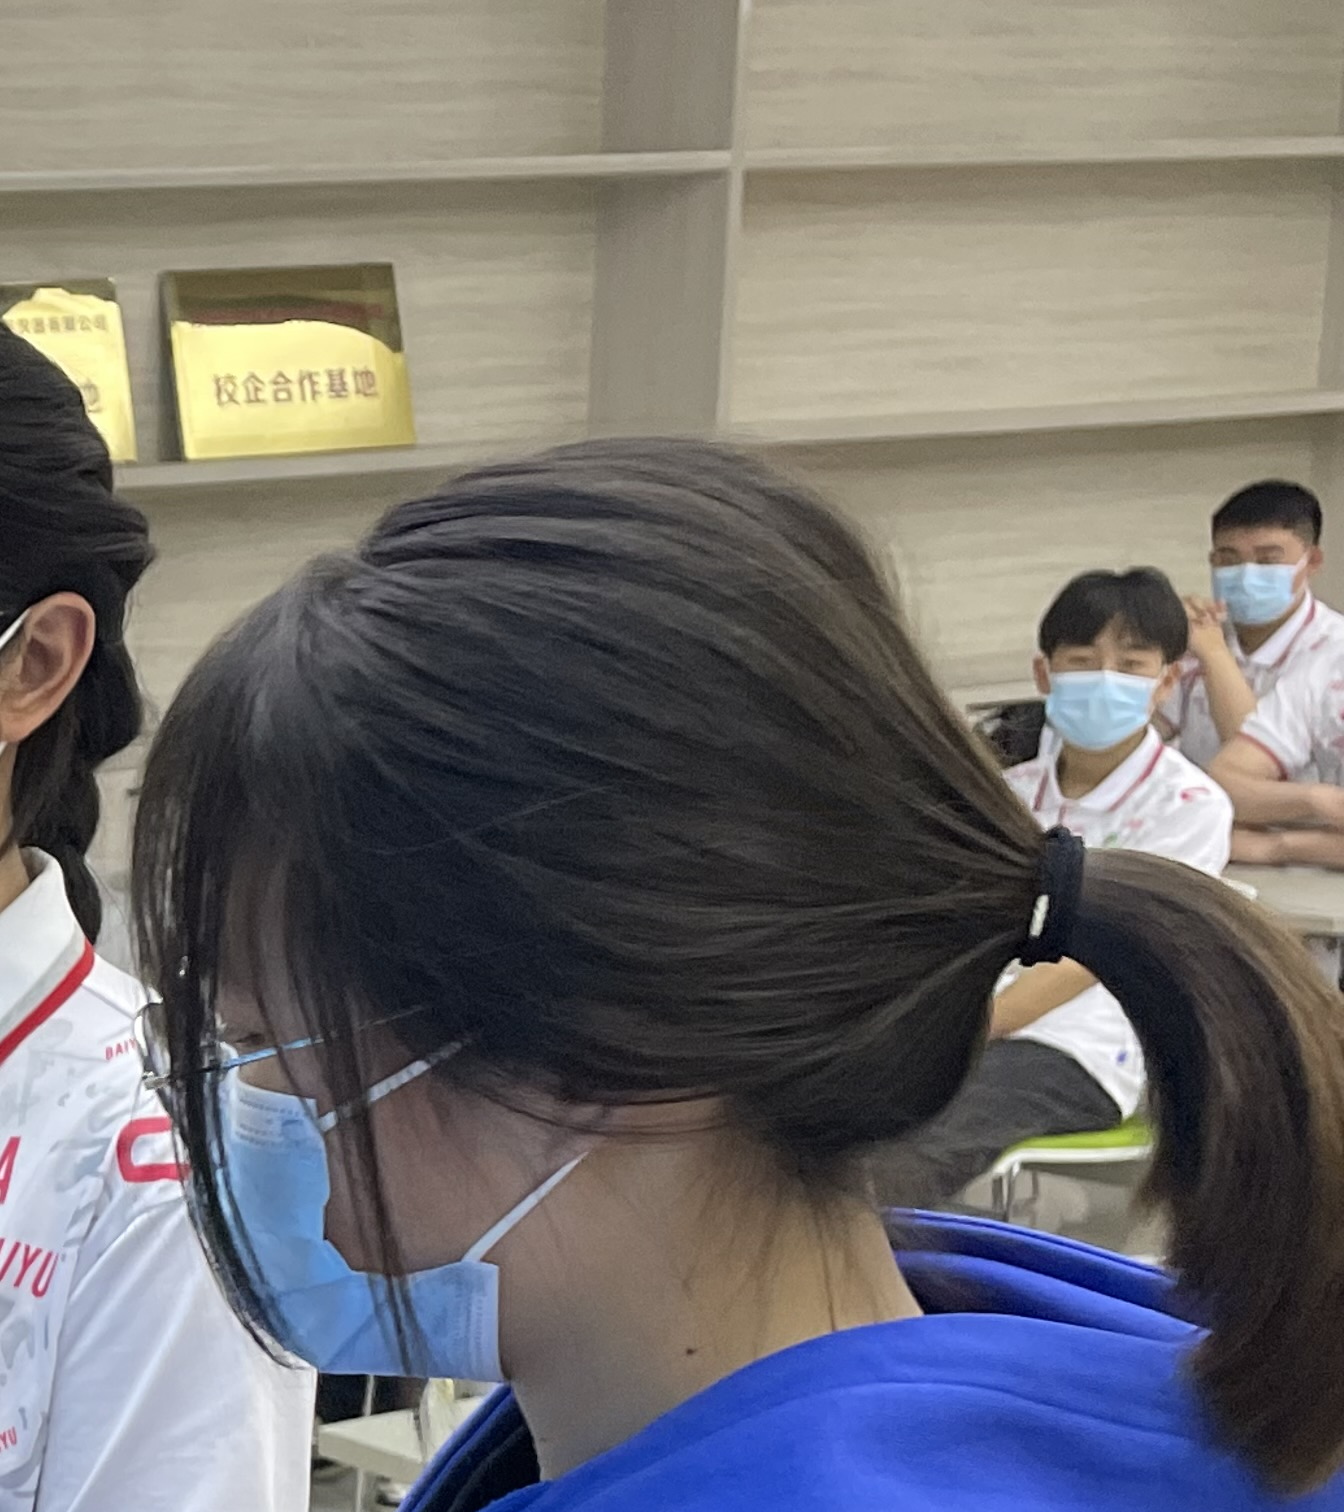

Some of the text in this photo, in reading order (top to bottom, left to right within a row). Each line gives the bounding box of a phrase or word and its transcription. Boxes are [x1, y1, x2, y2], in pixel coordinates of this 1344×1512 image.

[214, 366, 381, 408] 校企合作基地
